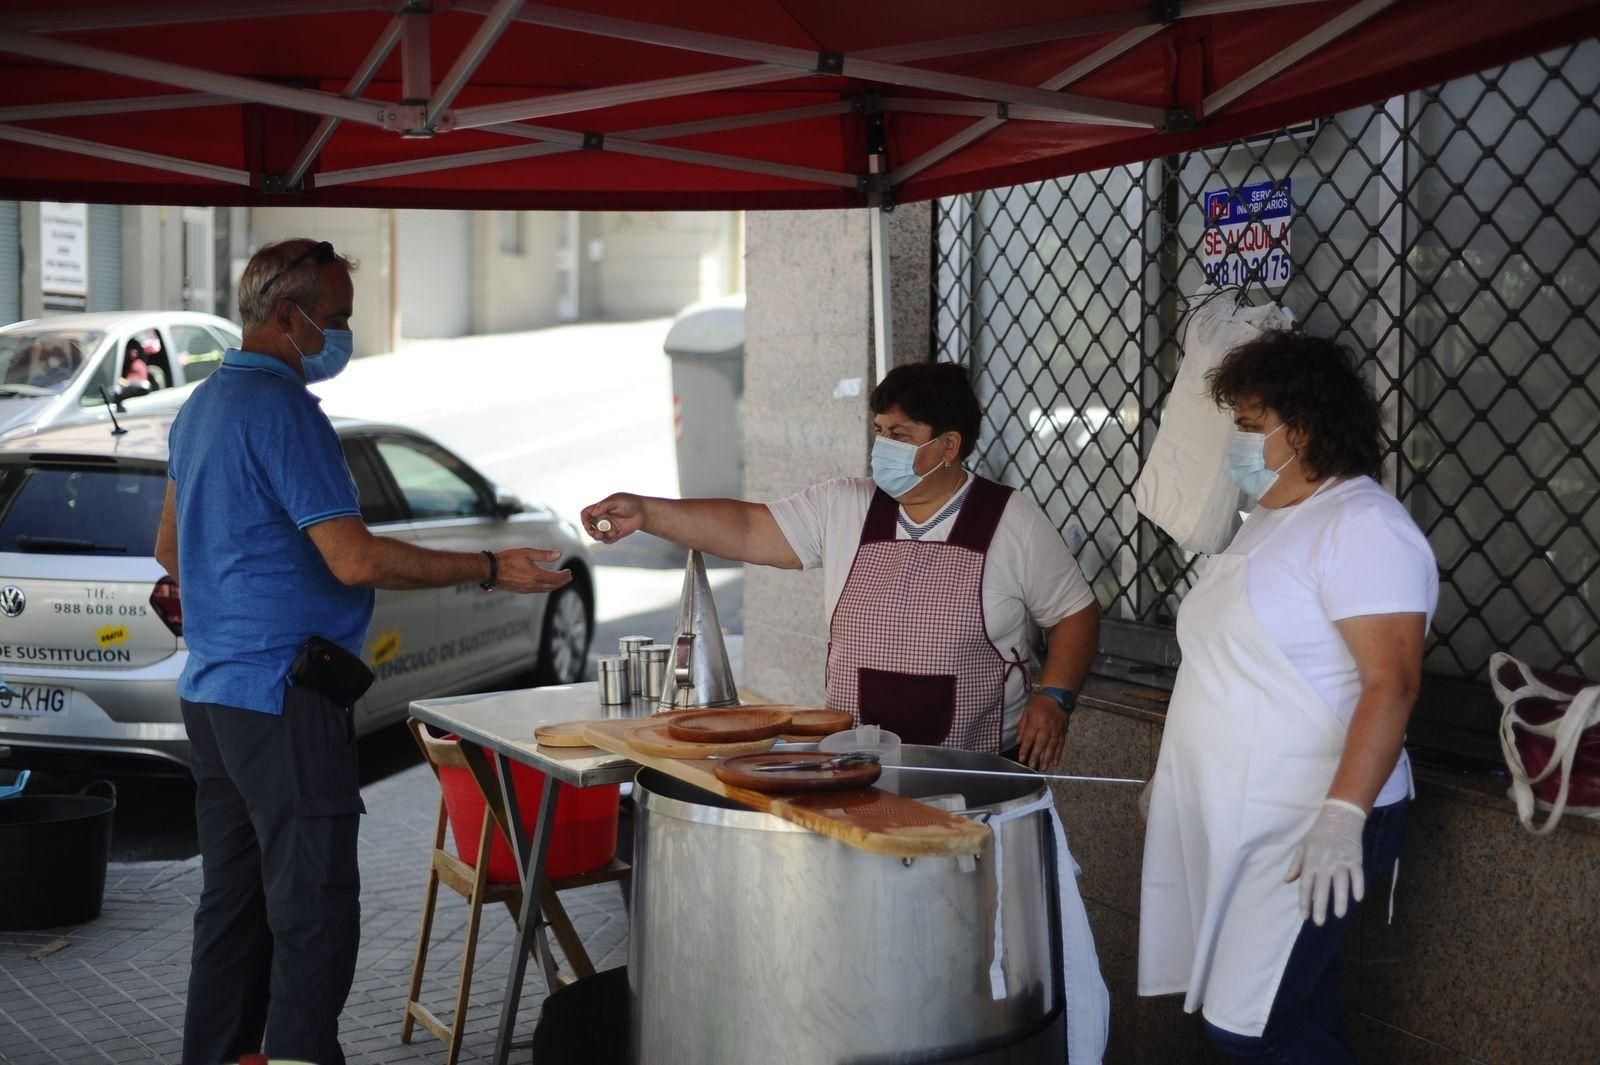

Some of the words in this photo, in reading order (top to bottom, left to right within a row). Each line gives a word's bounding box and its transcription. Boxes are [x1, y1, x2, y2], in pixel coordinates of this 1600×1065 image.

[1251, 186, 1288, 202] SERVCIO
[1236, 197, 1288, 215] INMOBILARIOS
[1204, 231, 1222, 256] SE
[54, 602, 81, 615] 988
[86, 604, 113, 616] 608
[118, 605, 147, 617] 085
[17, 646, 130, 662] SUSTITUCION
[21, 687, 64, 712] KHG
